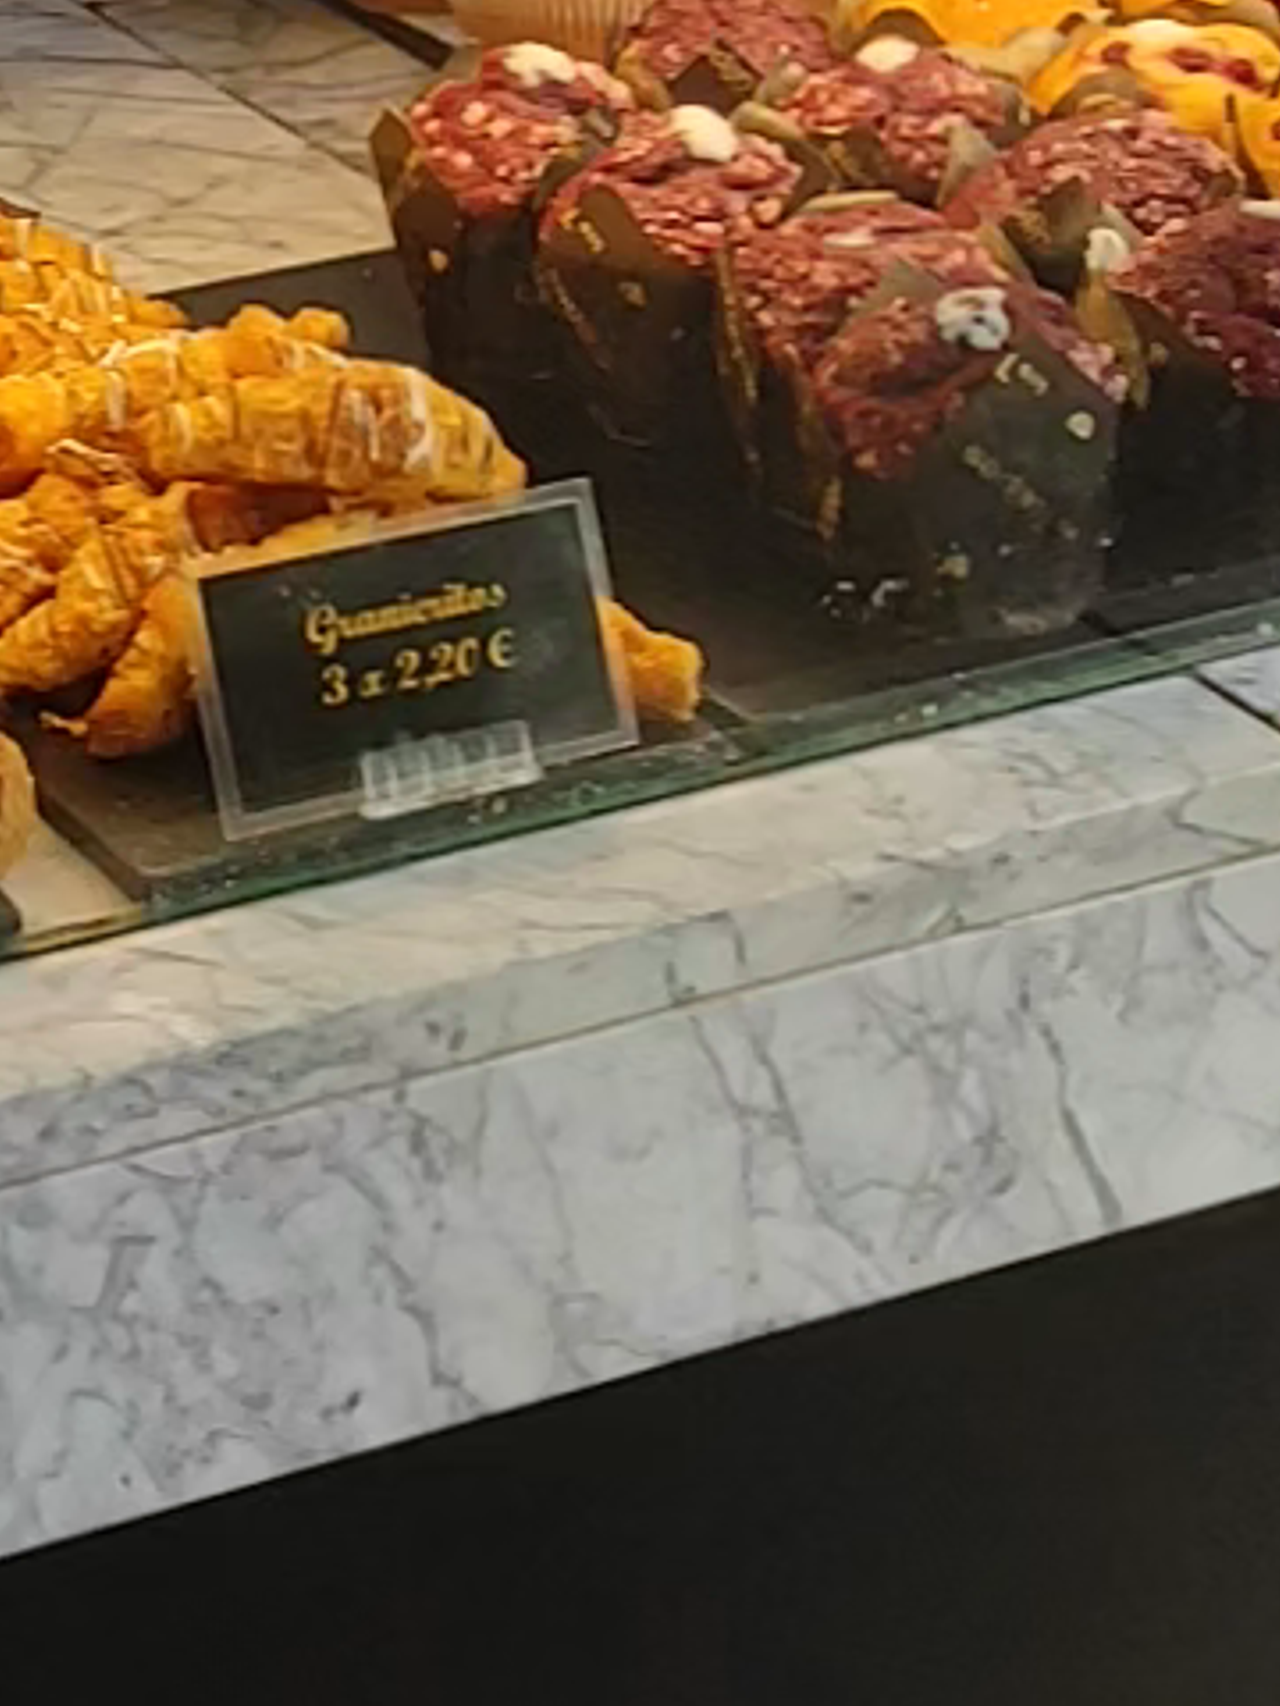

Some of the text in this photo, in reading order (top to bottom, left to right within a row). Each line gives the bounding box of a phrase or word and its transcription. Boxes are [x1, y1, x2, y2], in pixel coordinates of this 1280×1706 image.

[321, 663, 349, 705] 3
[396, 636, 480, 689] 2,20
[488, 627, 517, 669] €
